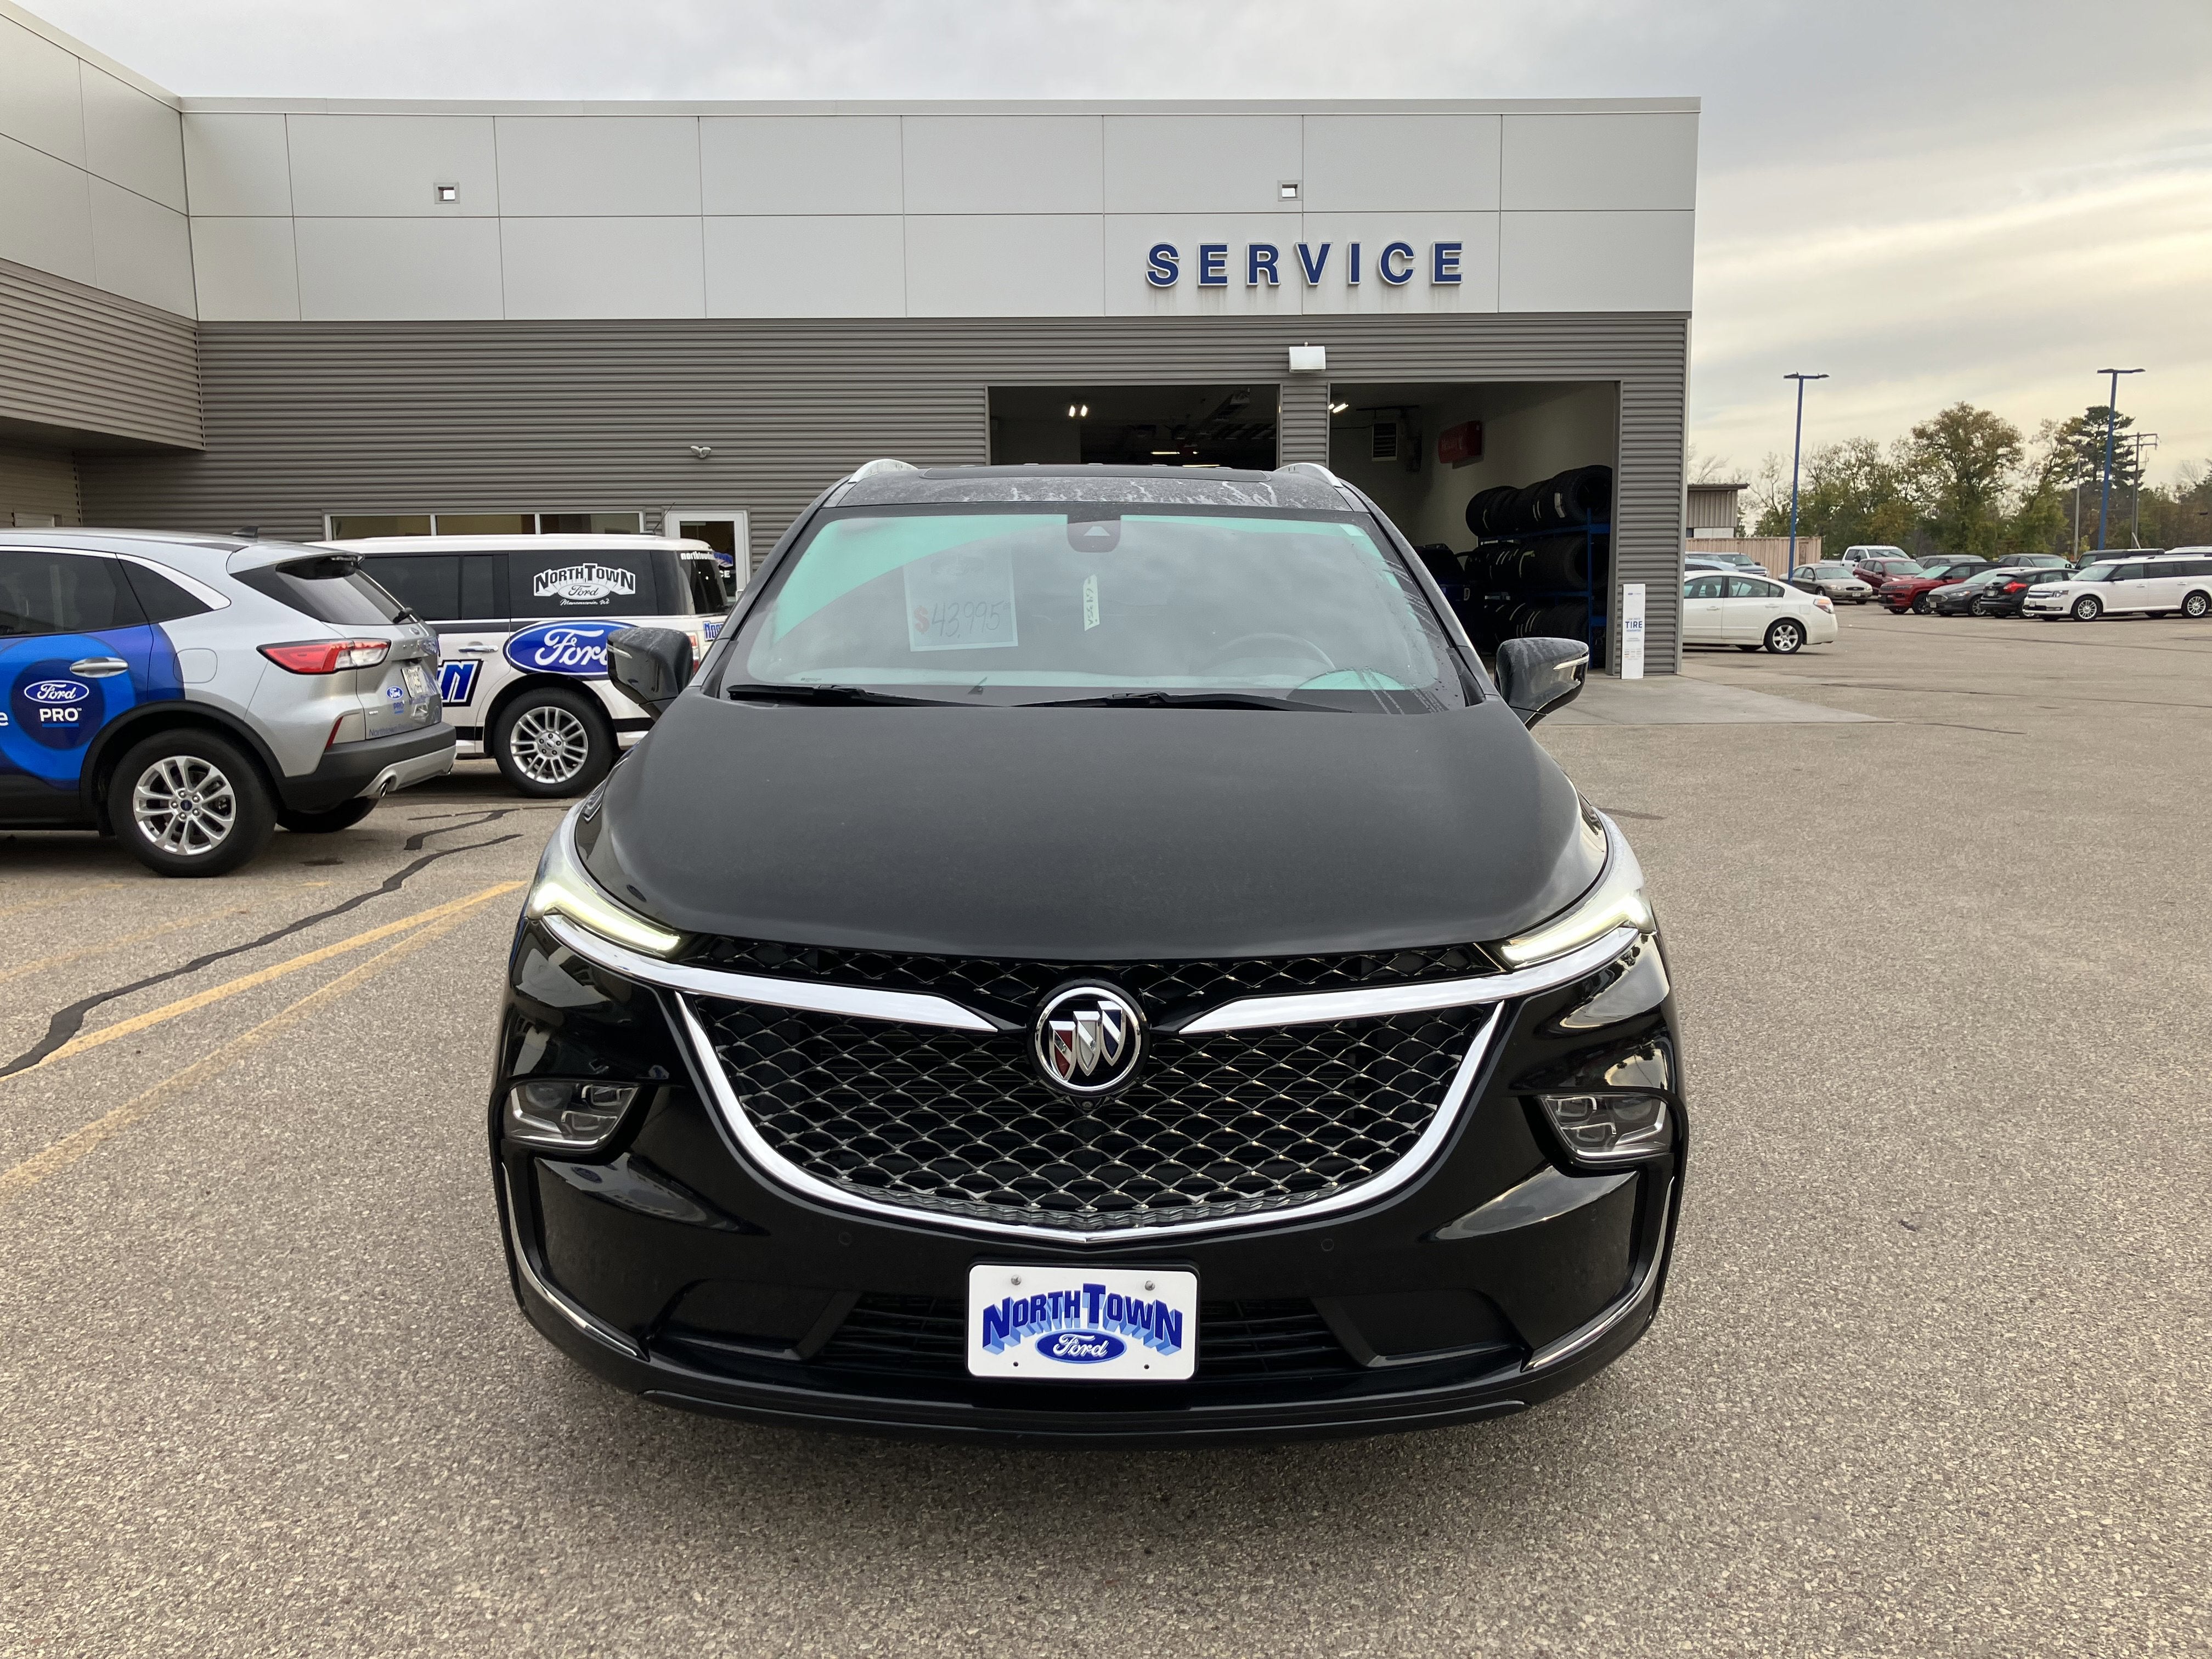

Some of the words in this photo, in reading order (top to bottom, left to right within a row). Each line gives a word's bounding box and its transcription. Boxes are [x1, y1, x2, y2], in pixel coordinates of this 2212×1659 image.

[1146, 240, 1464, 287] SERVICE
[568, 585, 599, 596] Ford
[704, 623, 724, 639] NOR
[1625, 620, 1643, 629] TIRE
[37, 683, 77, 699] Ford
[1053, 1333, 1109, 1358] Ford
